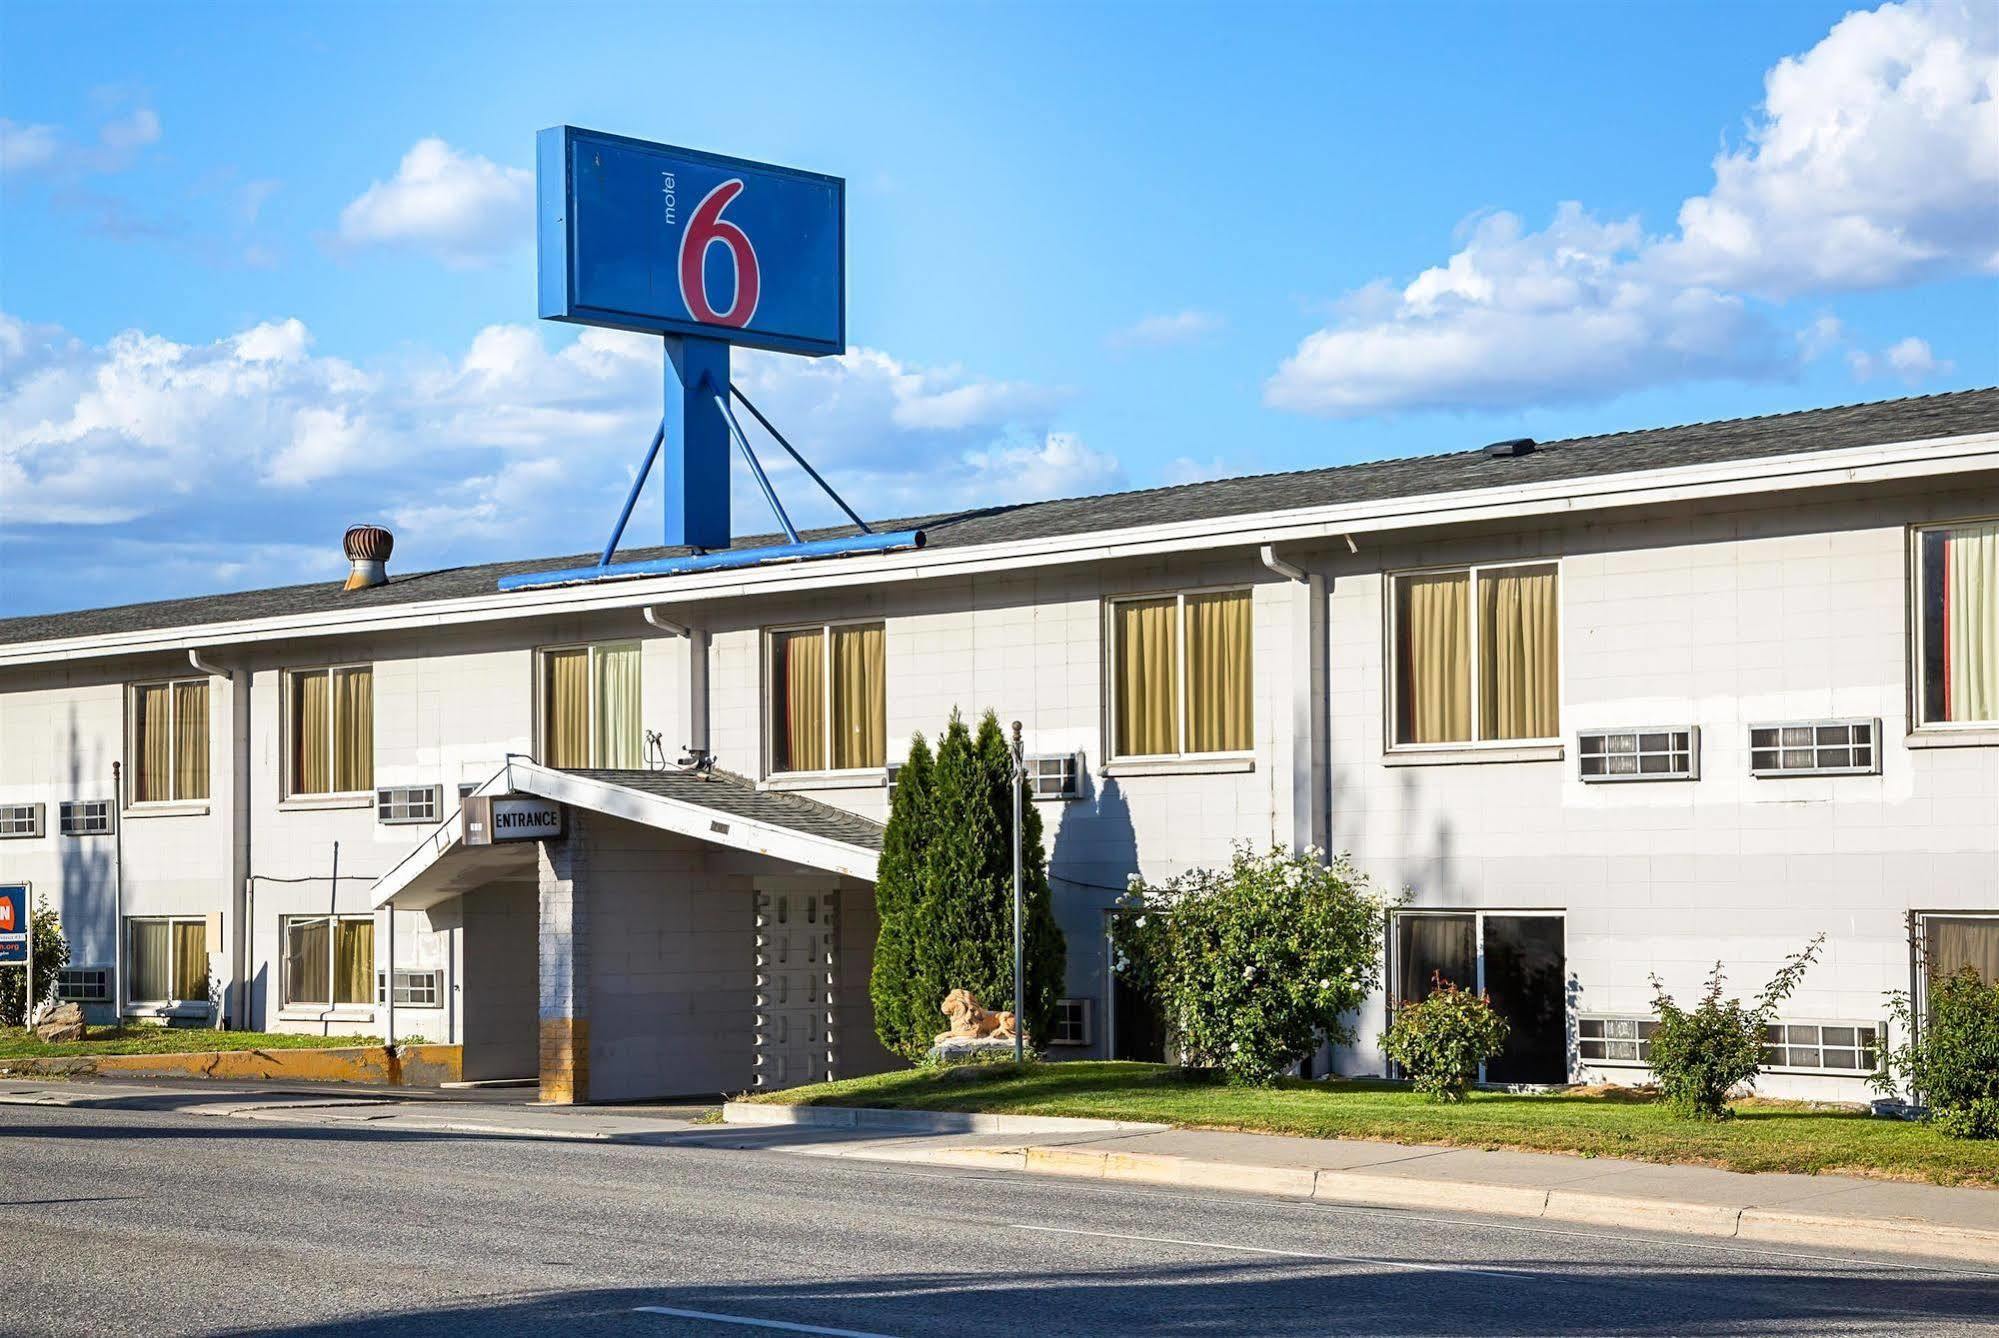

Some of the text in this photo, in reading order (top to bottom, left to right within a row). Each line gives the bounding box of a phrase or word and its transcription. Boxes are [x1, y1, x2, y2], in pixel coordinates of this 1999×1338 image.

[662, 172, 760, 328] motel 6
[496, 812, 557, 828] ENTRANCE
[0, 906, 10, 920] N
[0, 943, 19, 951] n.org
